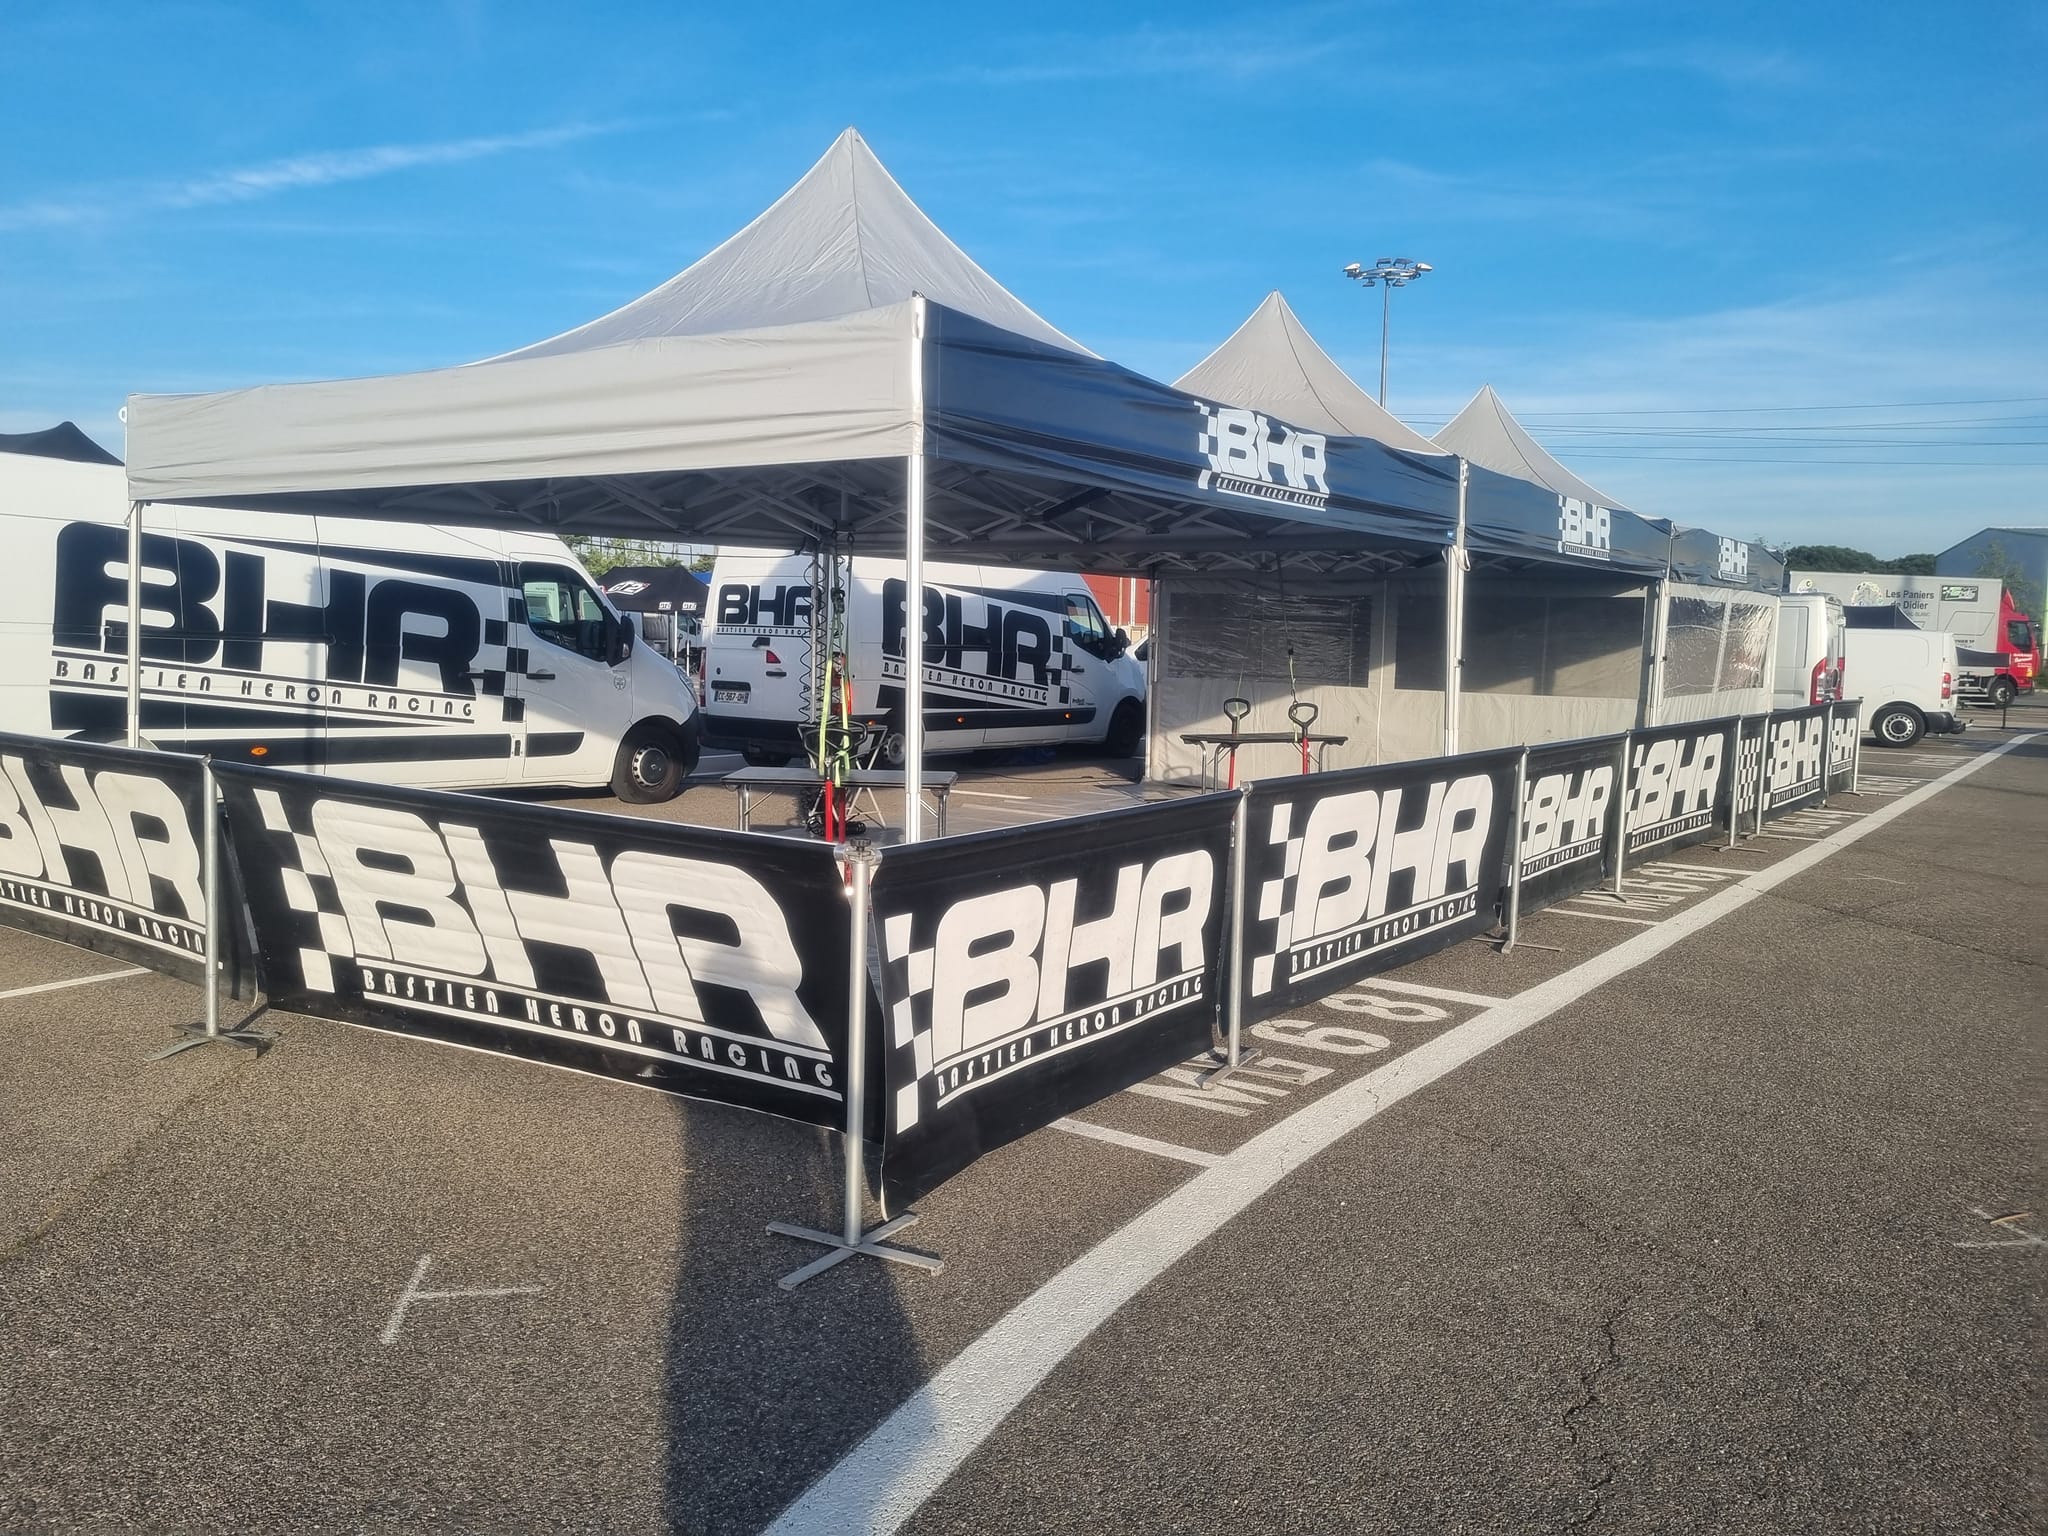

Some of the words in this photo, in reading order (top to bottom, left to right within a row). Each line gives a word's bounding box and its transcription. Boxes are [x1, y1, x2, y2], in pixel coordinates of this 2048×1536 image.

[1217, 408, 1329, 494] BHR
[1565, 497, 1610, 549] BHR
[1722, 538, 1748, 574] BHR
[53, 522, 481, 696] BHR
[882, 578, 1050, 685] BHR
[1886, 589, 1901, 598] Les
[1903, 590, 1934, 599] Paniers
[1903, 601, 1928, 610] Didier
[56, 660, 211, 691] BASIEN
[241, 679, 341, 704] HERON
[368, 693, 472, 717] RACING
[952, 675, 993, 691] HERON
[1003, 685, 1047, 701] RACING
[1773, 716, 1823, 788] BHR
[1832, 718, 1857, 762] BHR
[1525, 766, 1613, 859] BHR
[1634, 733, 1723, 829] BHR
[1291, 774, 1494, 941] BHR
[65, 895, 125, 929] HERON
[139, 917, 203, 953] RACIN
[312, 799, 830, 1051] BHR
[932, 849, 1214, 1061] BHR
[1292, 937, 1361, 974] BASTIEN
[1375, 913, 1420, 943] HERON
[363, 968, 499, 1014] BASTIEN
[526, 997, 643, 1044] HERON
[673, 1030, 832, 1086] RACING
[937, 1040, 1032, 1097] BASTIEN
[1051, 1011, 1119, 1049] HERON
[1136, 976, 1202, 1016] RACING
